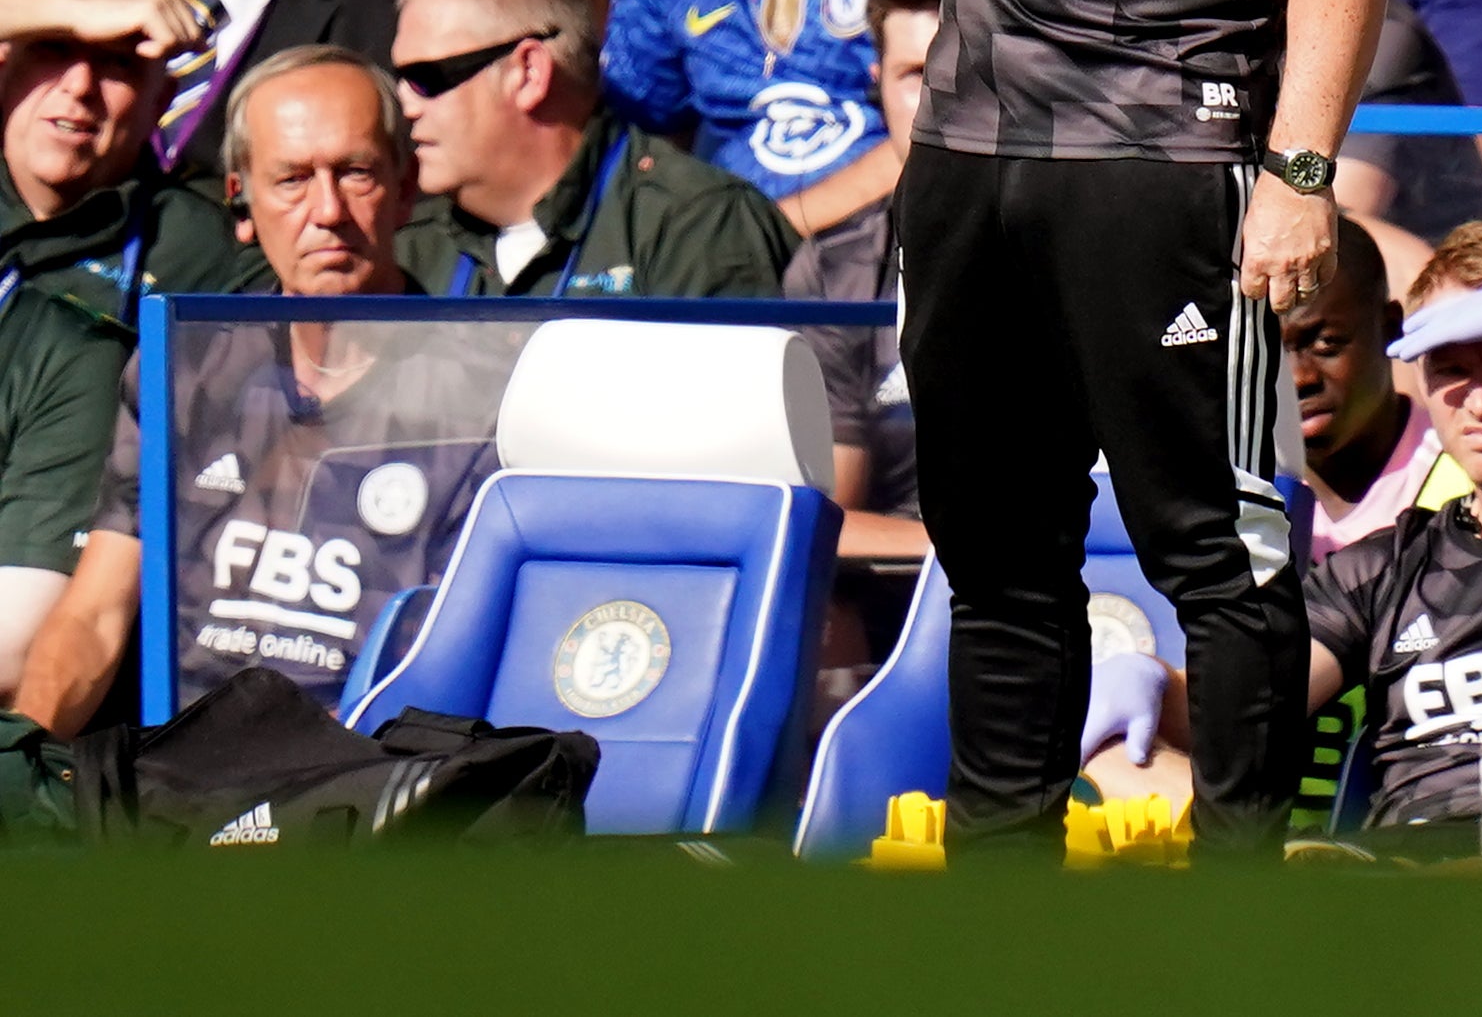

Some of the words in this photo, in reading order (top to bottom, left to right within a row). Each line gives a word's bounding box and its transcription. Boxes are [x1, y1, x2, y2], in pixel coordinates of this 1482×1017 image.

[1201, 82, 1239, 107] BR
[1161, 328, 1218, 347] adidas
[213, 519, 361, 612] FBS
[258, 634, 346, 671] online
[209, 827, 279, 847] adidas
